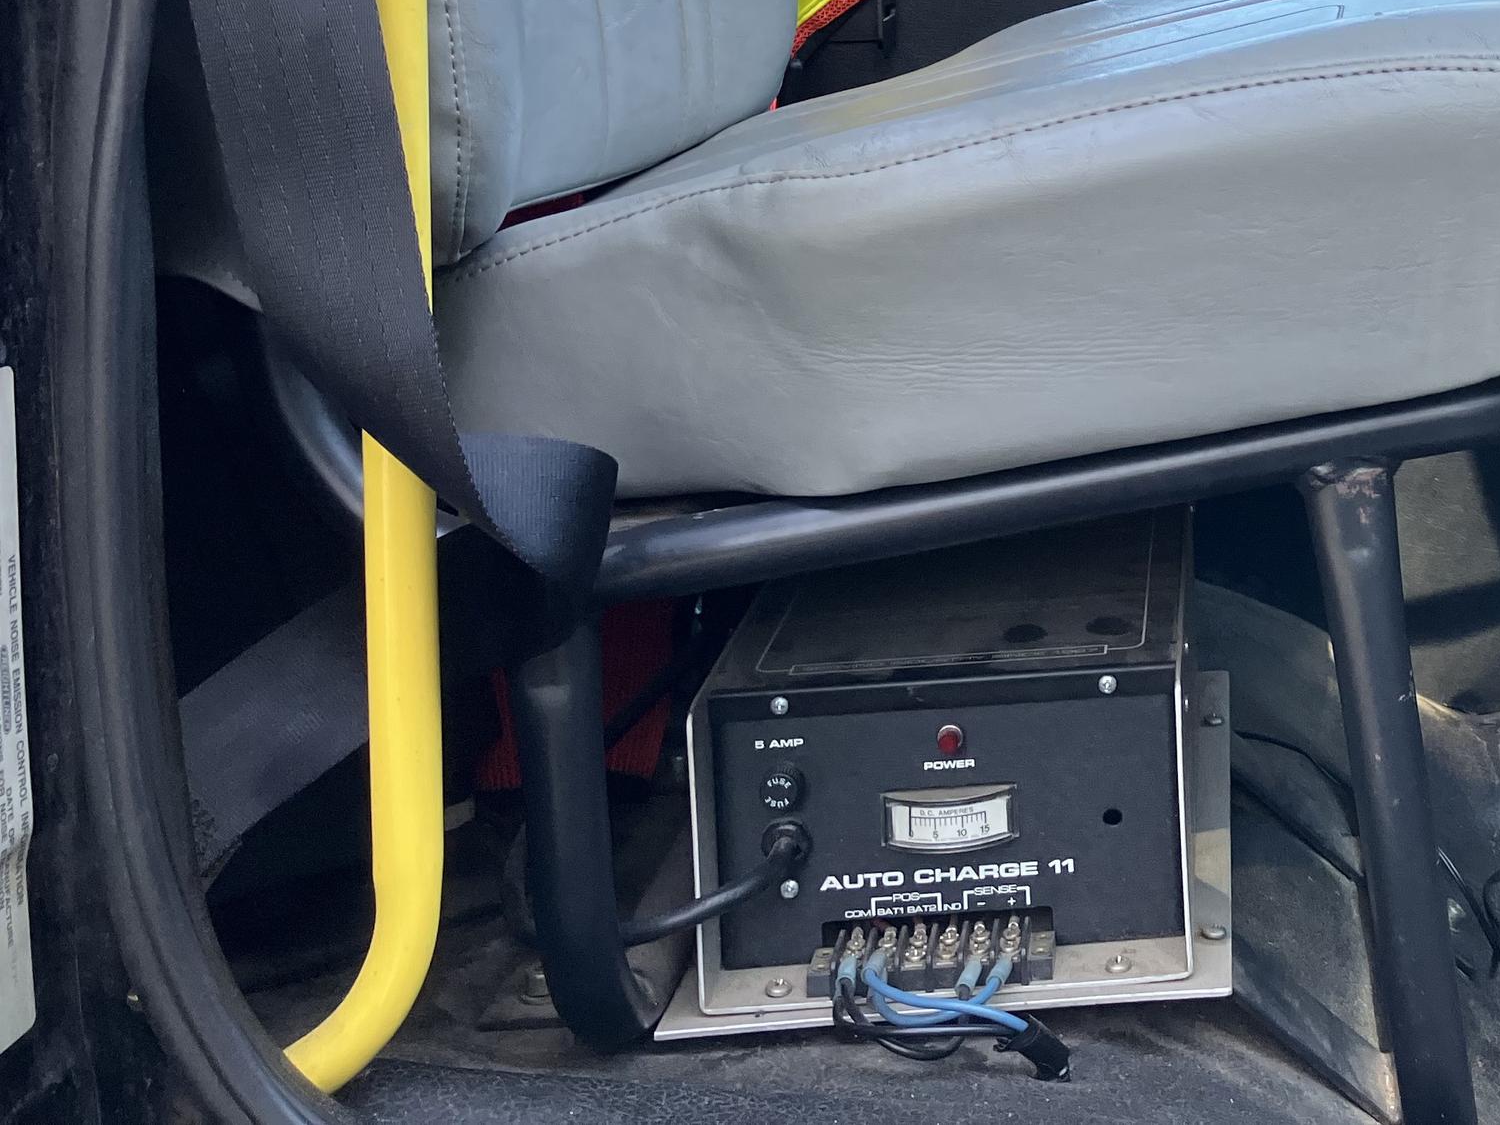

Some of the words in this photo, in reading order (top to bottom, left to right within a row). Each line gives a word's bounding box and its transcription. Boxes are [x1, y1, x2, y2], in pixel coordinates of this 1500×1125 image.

[8, 554, 18, 614] VEHICLE
[10, 619, 20, 662] NOISE
[12, 668, 23, 734] EMISSION
[754, 740, 765, 750] 5
[769, 738, 804, 749] AMP
[923, 759, 975, 771] POWER
[17, 740, 28, 807] CONTROL
[767, 777, 792, 789] FUSE
[6, 787, 14, 822] DATE
[764, 796, 790, 809] FUSE
[939, 806, 974, 816] AMPERES
[9, 828, 15, 845] OF
[933, 830, 938, 839] 5
[957, 828, 968, 837] 10
[980, 823, 990, 833] 15
[16, 811, 29, 906] INFORMATION
[820, 871, 905, 892] AUTO
[913, 860, 1039, 885] CHARGE
[1047, 858, 1076, 875] 11
[892, 892, 920, 903] POS
[974, 884, 1018, 896] SENSE
[844, 909, 872, 919] COM
[877, 906, 905, 916] BAT1
[906, 904, 938, 915] BAT2
